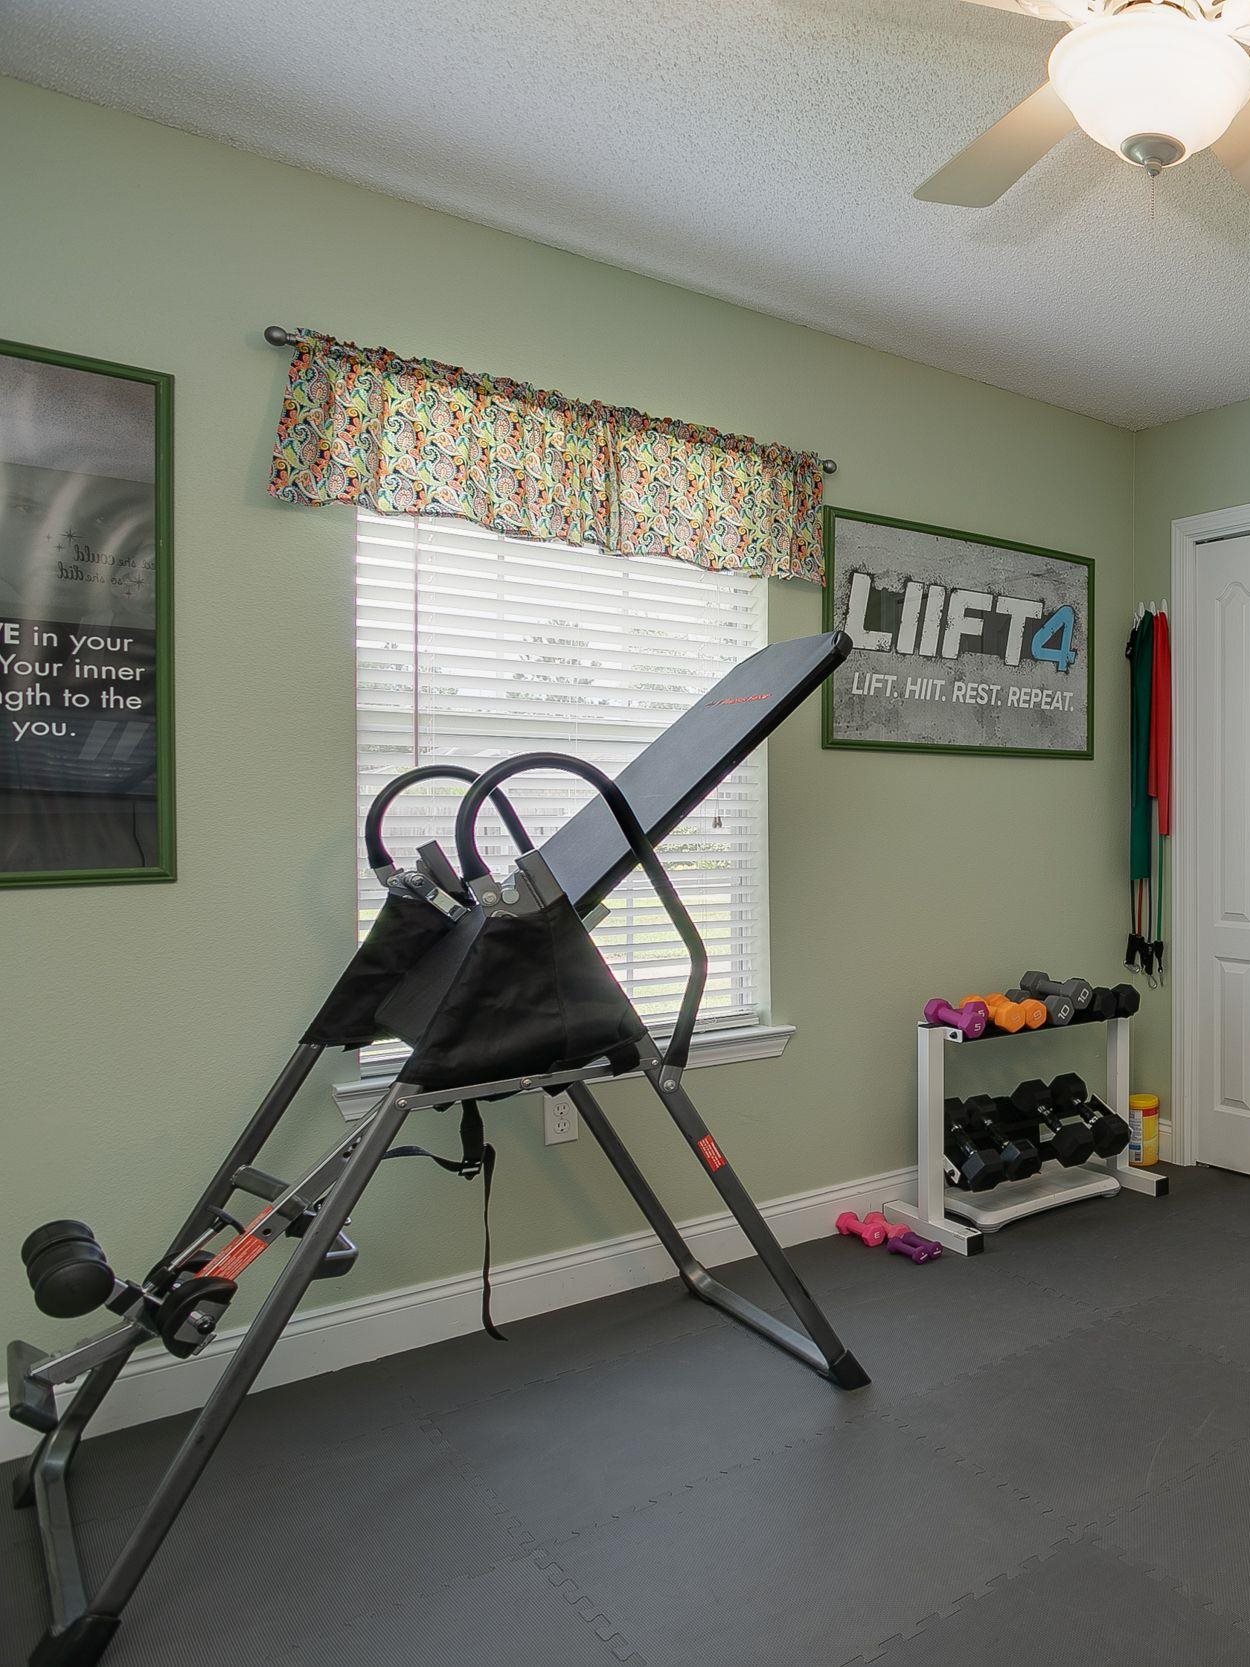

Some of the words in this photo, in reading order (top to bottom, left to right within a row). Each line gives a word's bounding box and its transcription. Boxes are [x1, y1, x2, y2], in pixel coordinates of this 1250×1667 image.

[0, 622, 20, 645] E
[33, 626, 58, 647] in
[69, 634, 134, 655] your
[0, 653, 63, 677] Your
[75, 659, 146, 681] inner
[0, 683, 51, 711] gth
[63, 689, 90, 708] to
[101, 686, 143, 710] the
[851, 672, 899, 699] LIFT.
[904, 677, 946, 702] HIIT.
[952, 681, 1002, 707] REST.
[1007, 686, 1075, 712] REPEAT.
[12, 720, 76, 742] you.
[1077, 988, 1089, 1003] 10
[1058, 1004, 1070, 1020] 10
[974, 1023, 982, 1031] 5
